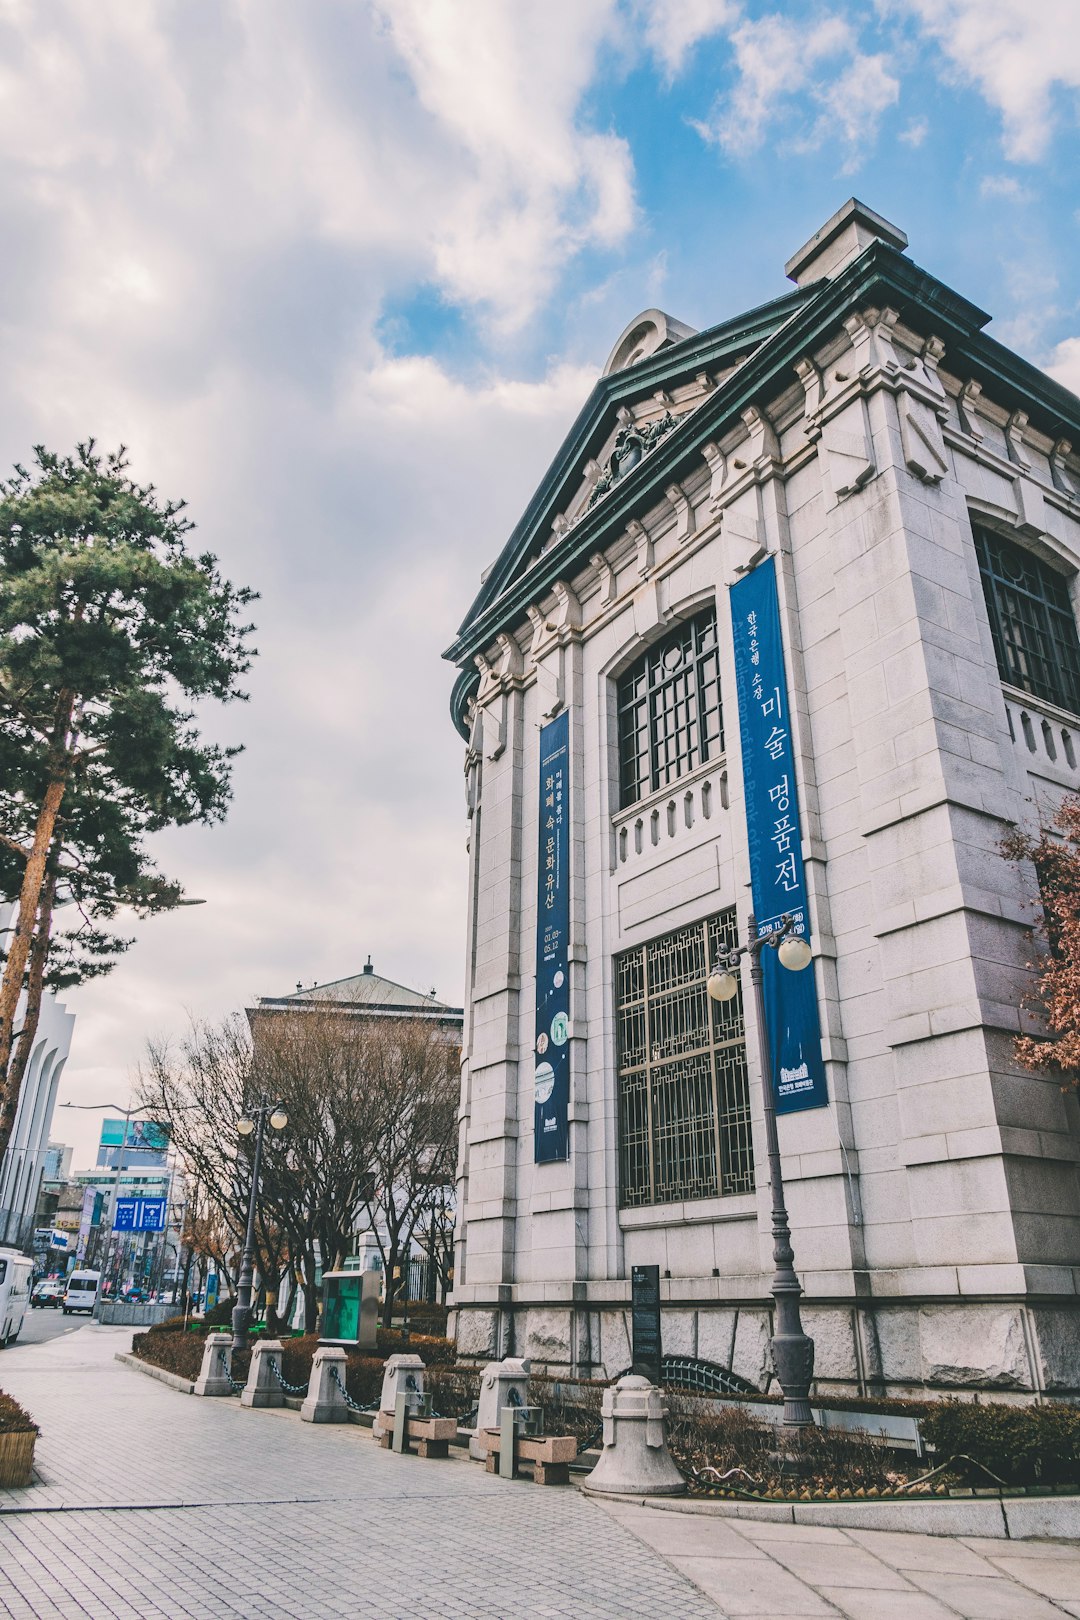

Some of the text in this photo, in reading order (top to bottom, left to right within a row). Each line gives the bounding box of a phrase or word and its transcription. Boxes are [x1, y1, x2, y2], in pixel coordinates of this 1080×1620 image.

[747, 611, 764, 700] 한국은행 소장
[762, 686, 799, 892] 미술 명품전
